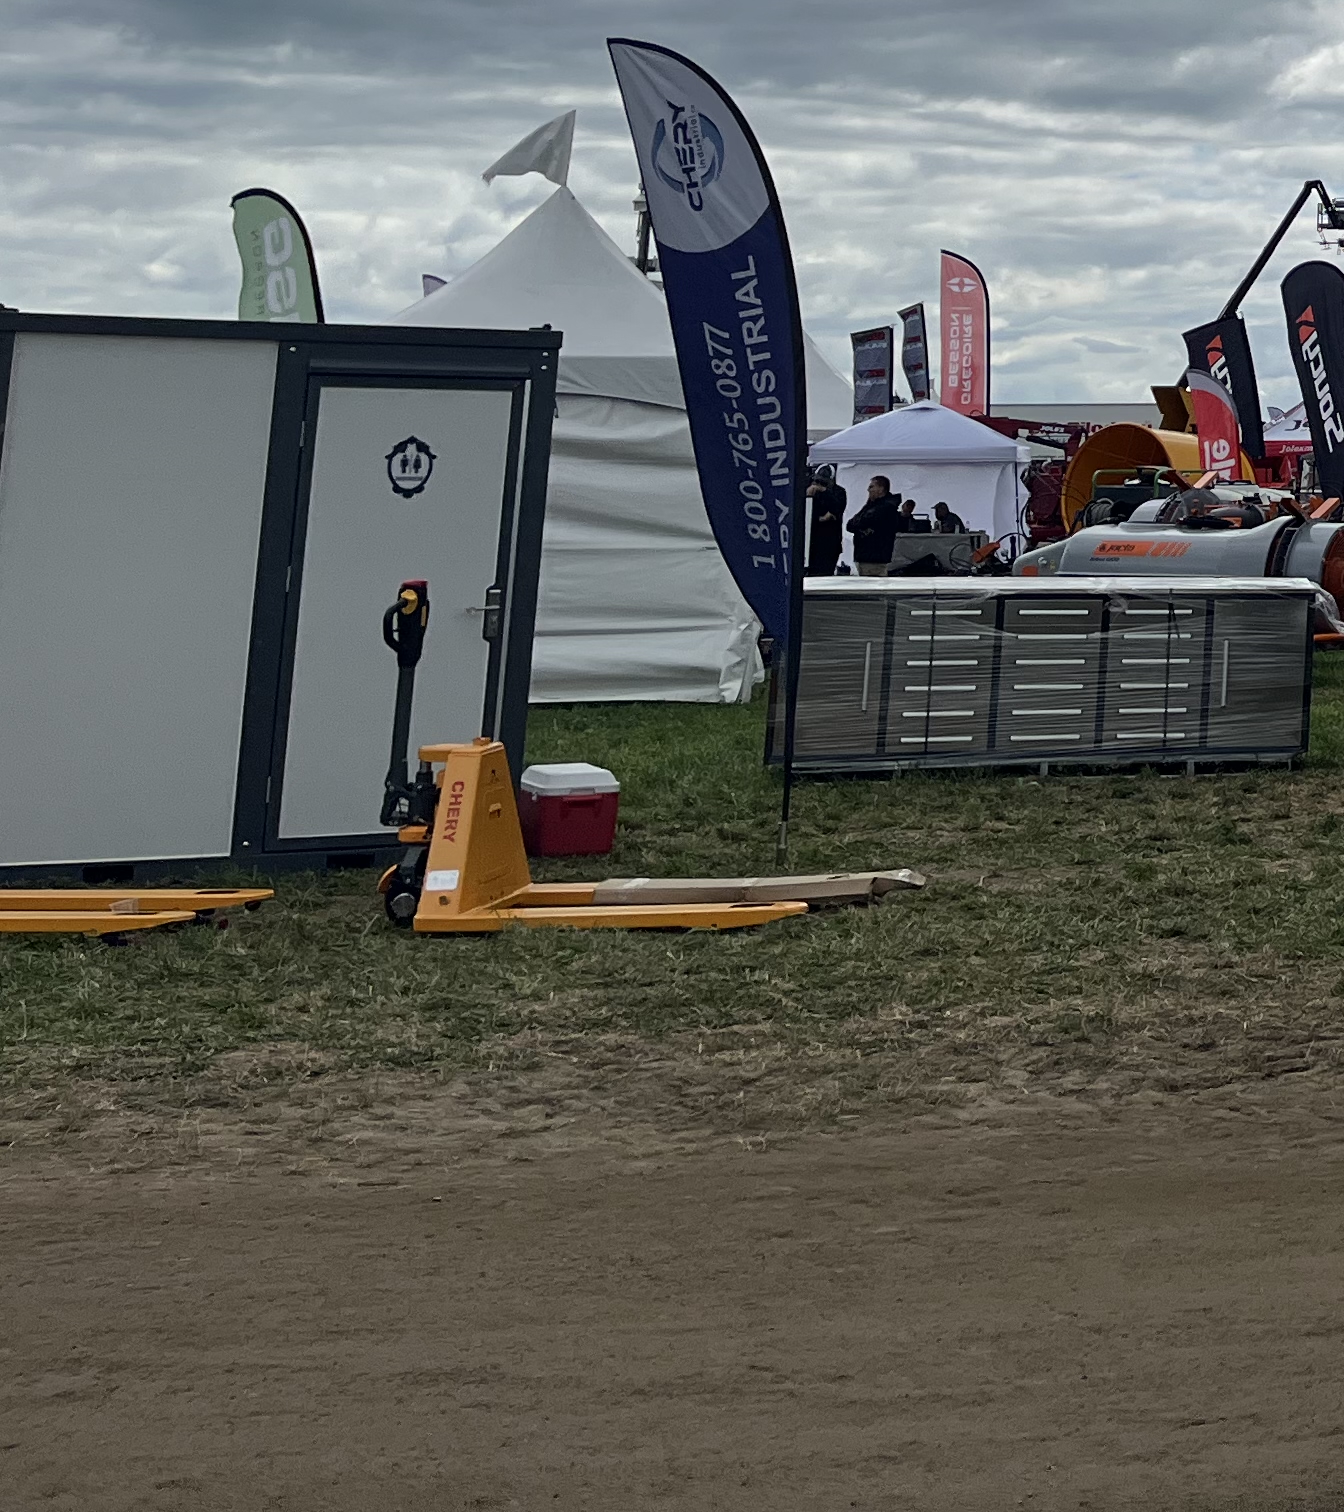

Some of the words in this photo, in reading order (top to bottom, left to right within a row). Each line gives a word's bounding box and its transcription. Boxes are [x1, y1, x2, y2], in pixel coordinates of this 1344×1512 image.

[664, 99, 704, 212] CHERY
[730, 255, 790, 486] INDUSTRIAL
[703, 322, 772, 545] 800-765-0877
[752, 546, 776, 569] 1
[443, 780, 464, 843] CHERY
